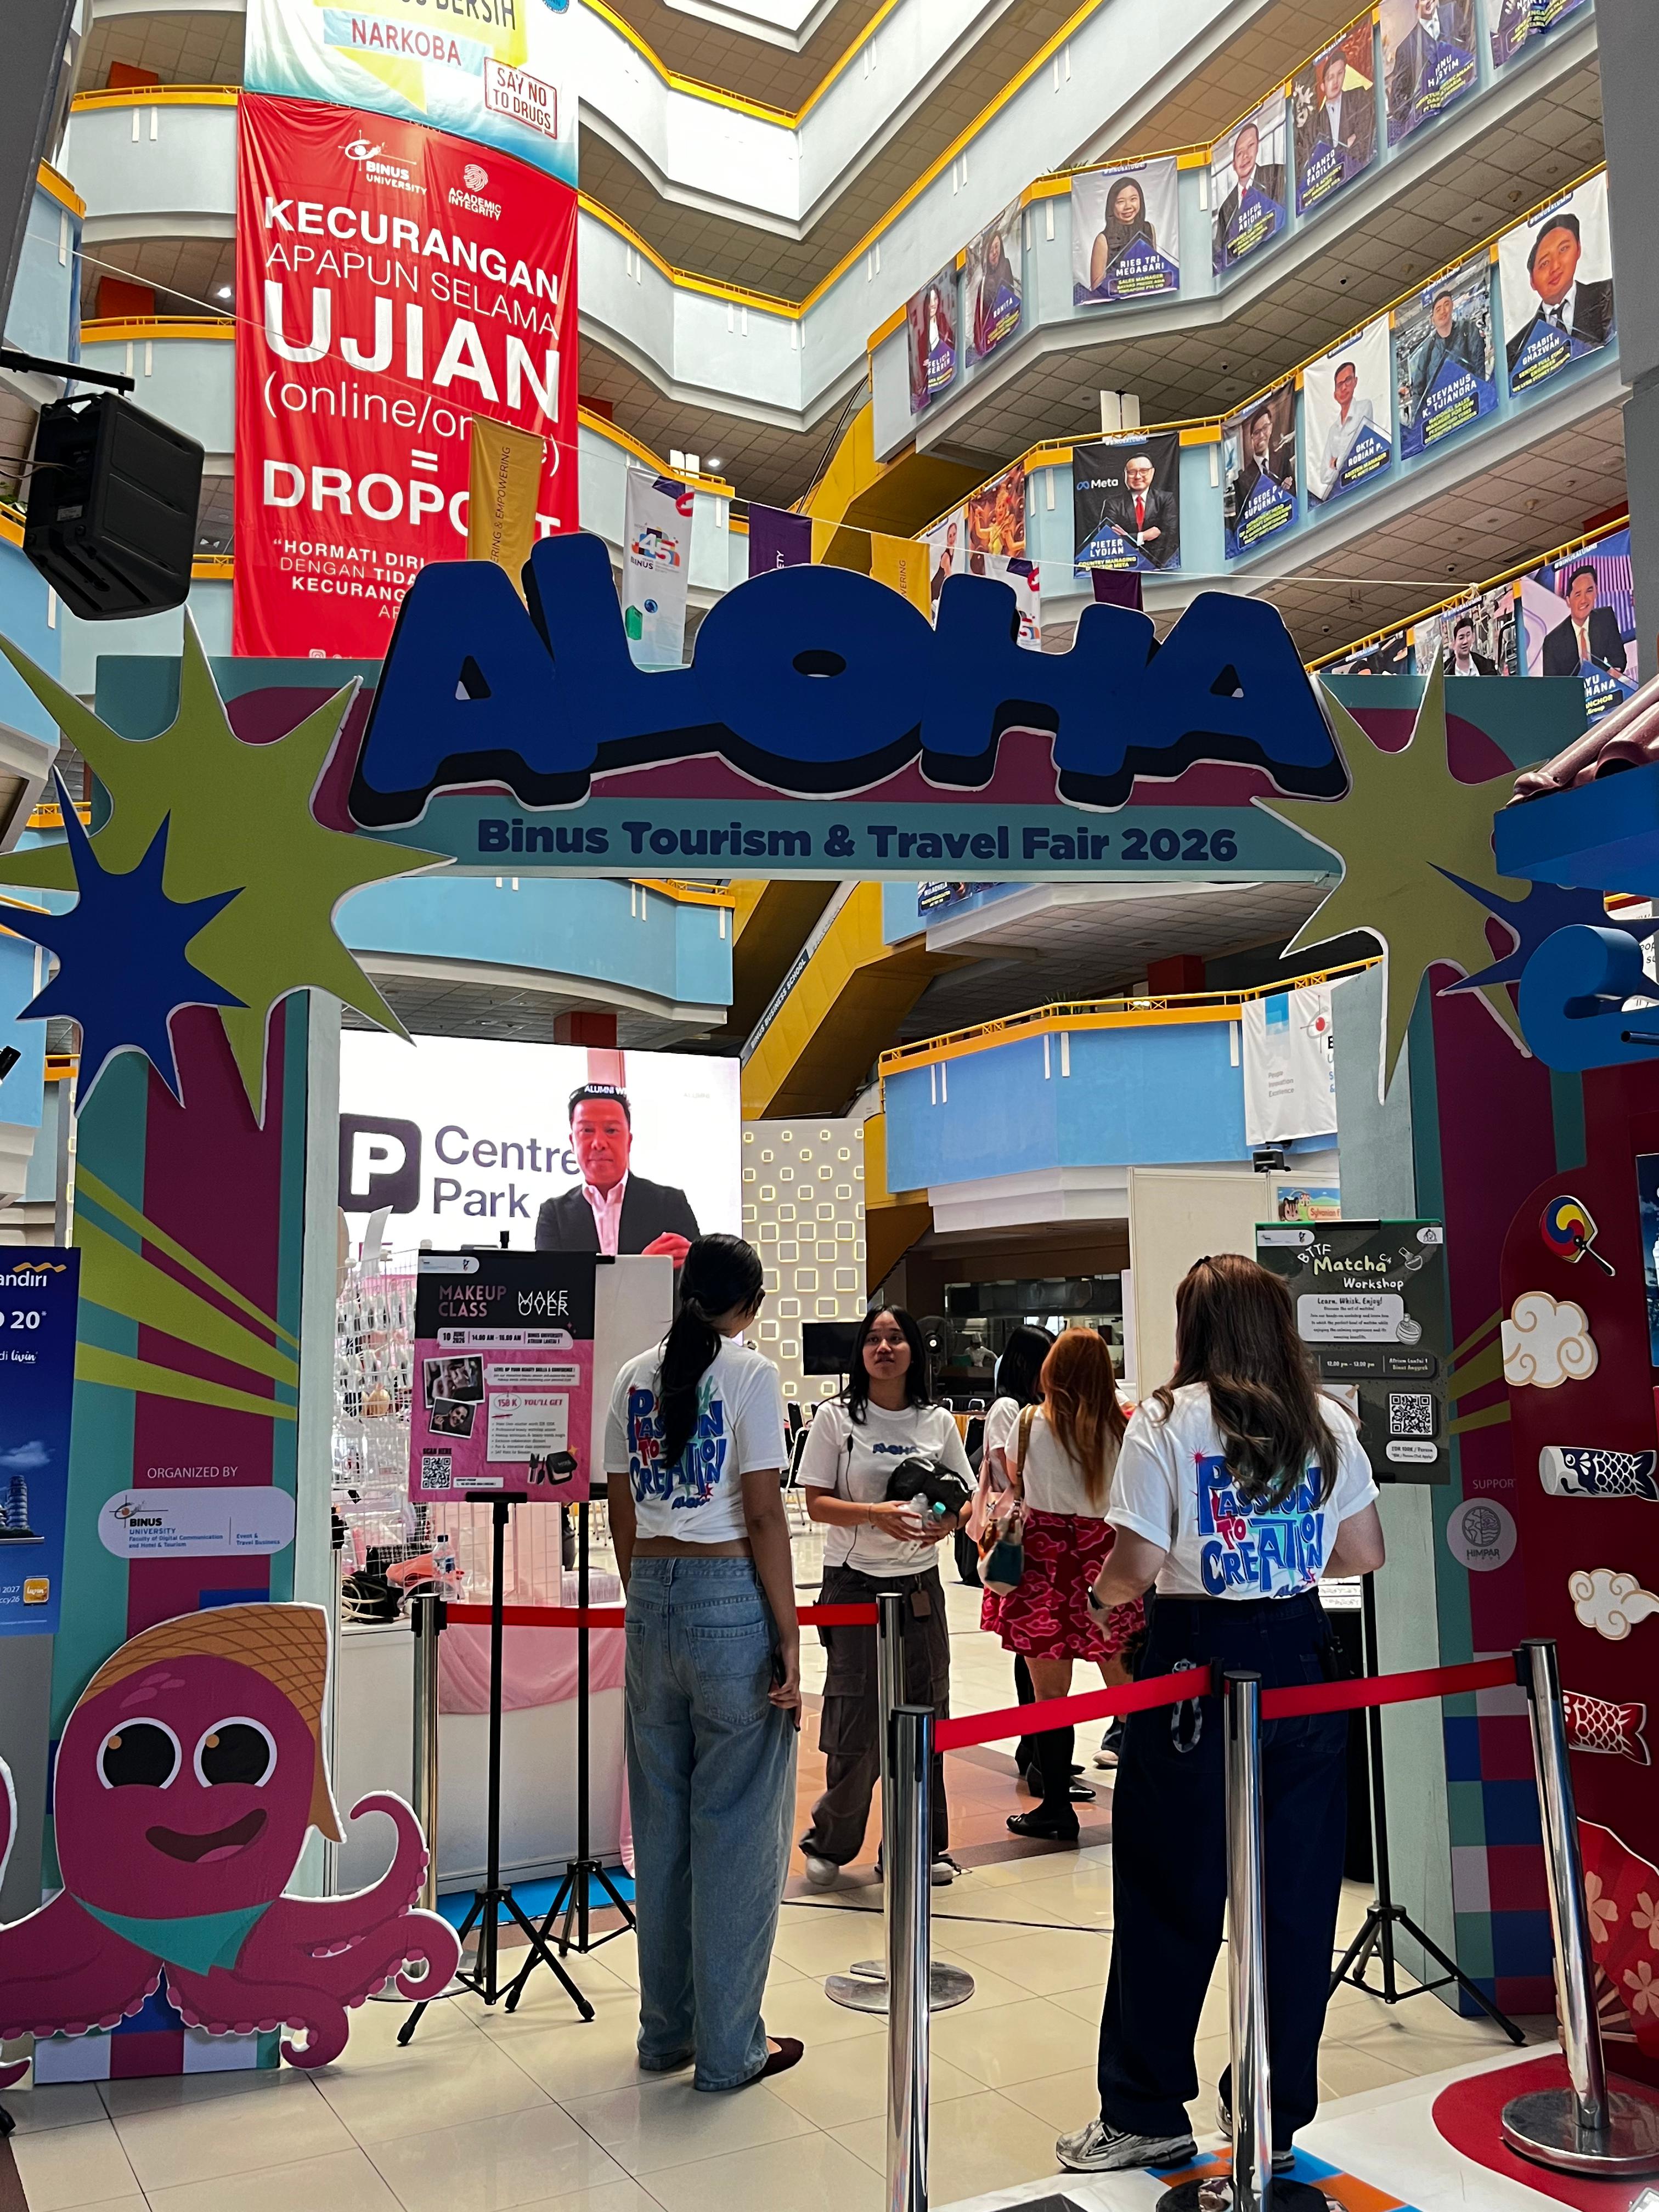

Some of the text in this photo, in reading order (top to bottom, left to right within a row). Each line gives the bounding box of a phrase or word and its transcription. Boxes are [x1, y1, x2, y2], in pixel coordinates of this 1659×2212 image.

[436, 0, 516, 31] ERSIH
[351, 19, 461, 66] NARKOBA
[497, 66, 547, 108] SAY NO
[494, 89, 552, 130] TO DRUGS
[366, 161, 409, 180] BINUS
[366, 174, 427, 195] UNIVERSITY
[449, 188, 501, 213] ACADEMIC
[449, 195, 501, 221] INTEGRITY
[1238, 202, 1262, 221] SAIFUL
[265, 196, 558, 304] KECURANGAN
[1116, 262, 1164, 277] MEGASARI
[1120, 255, 1160, 268] RIES TRI
[266, 243, 558, 340] APAPUN SELAMA
[264, 279, 559, 424] UJIAN
[1522, 337, 1560, 365] GHAZWAN
[1527, 332, 1554, 353] TSABIT
[1422, 380, 1477, 419] K. TJIANDRA
[1426, 373, 1471, 407] STEVANUS
[1348, 443, 1383, 467] ROBIAN P.
[1356, 438, 1374, 453] OKTA
[495, 446, 511, 520] EMPOWERING
[1091, 478, 1119, 489] Meta
[263, 460, 561, 538] DROPT
[1244, 490, 1284, 520] SUPURNA Y
[1253, 490, 1268, 505] GEDE
[1272, 485, 1277, 494] P
[638, 533, 674, 563] 45
[1090, 546, 1124, 557] LYDIAN
[1091, 538, 1124, 549] PIETER
[280, 557, 365, 579] DENGAN
[386, 552, 424, 569] DIRI
[354, 532, 1342, 812] ALOHA
[478, 819, 1238, 862] Binus Tourism & Travel Fair 2026
[751, 958, 806, 1049] BINUS BUSINESS SCHOOL
[584, 1085, 614, 1095] ALUMNI
[435, 1125, 580, 1175] Centre
[433, 1177, 531, 1218] Park
[1297, 1244, 1331, 1263] BTTF
[1313, 1255, 1386, 1276] Matcha
[439, 1285, 507, 1301] MAKEUP
[1344, 1277, 1404, 1291] Workshop
[438, 1302, 488, 1317] CLASS
[518, 1300, 569, 1316] OVER
[1362, 1296, 1383, 1306] Enjoy!
[443, 1332, 451, 1341] 10
[627, 1388, 725, 1454] PASN
[637, 1438, 659, 1466] TO
[147, 1466, 239, 1479] ORGANIZED BY
[1472, 1479, 1516, 1489] SUPPOR
[129, 1517, 162, 1527] BINUS
[1216, 1518, 1248, 1550] TO
[1466, 1548, 1500, 1559] HIMPAR
[2, 1585, 20, 1594] 2027
